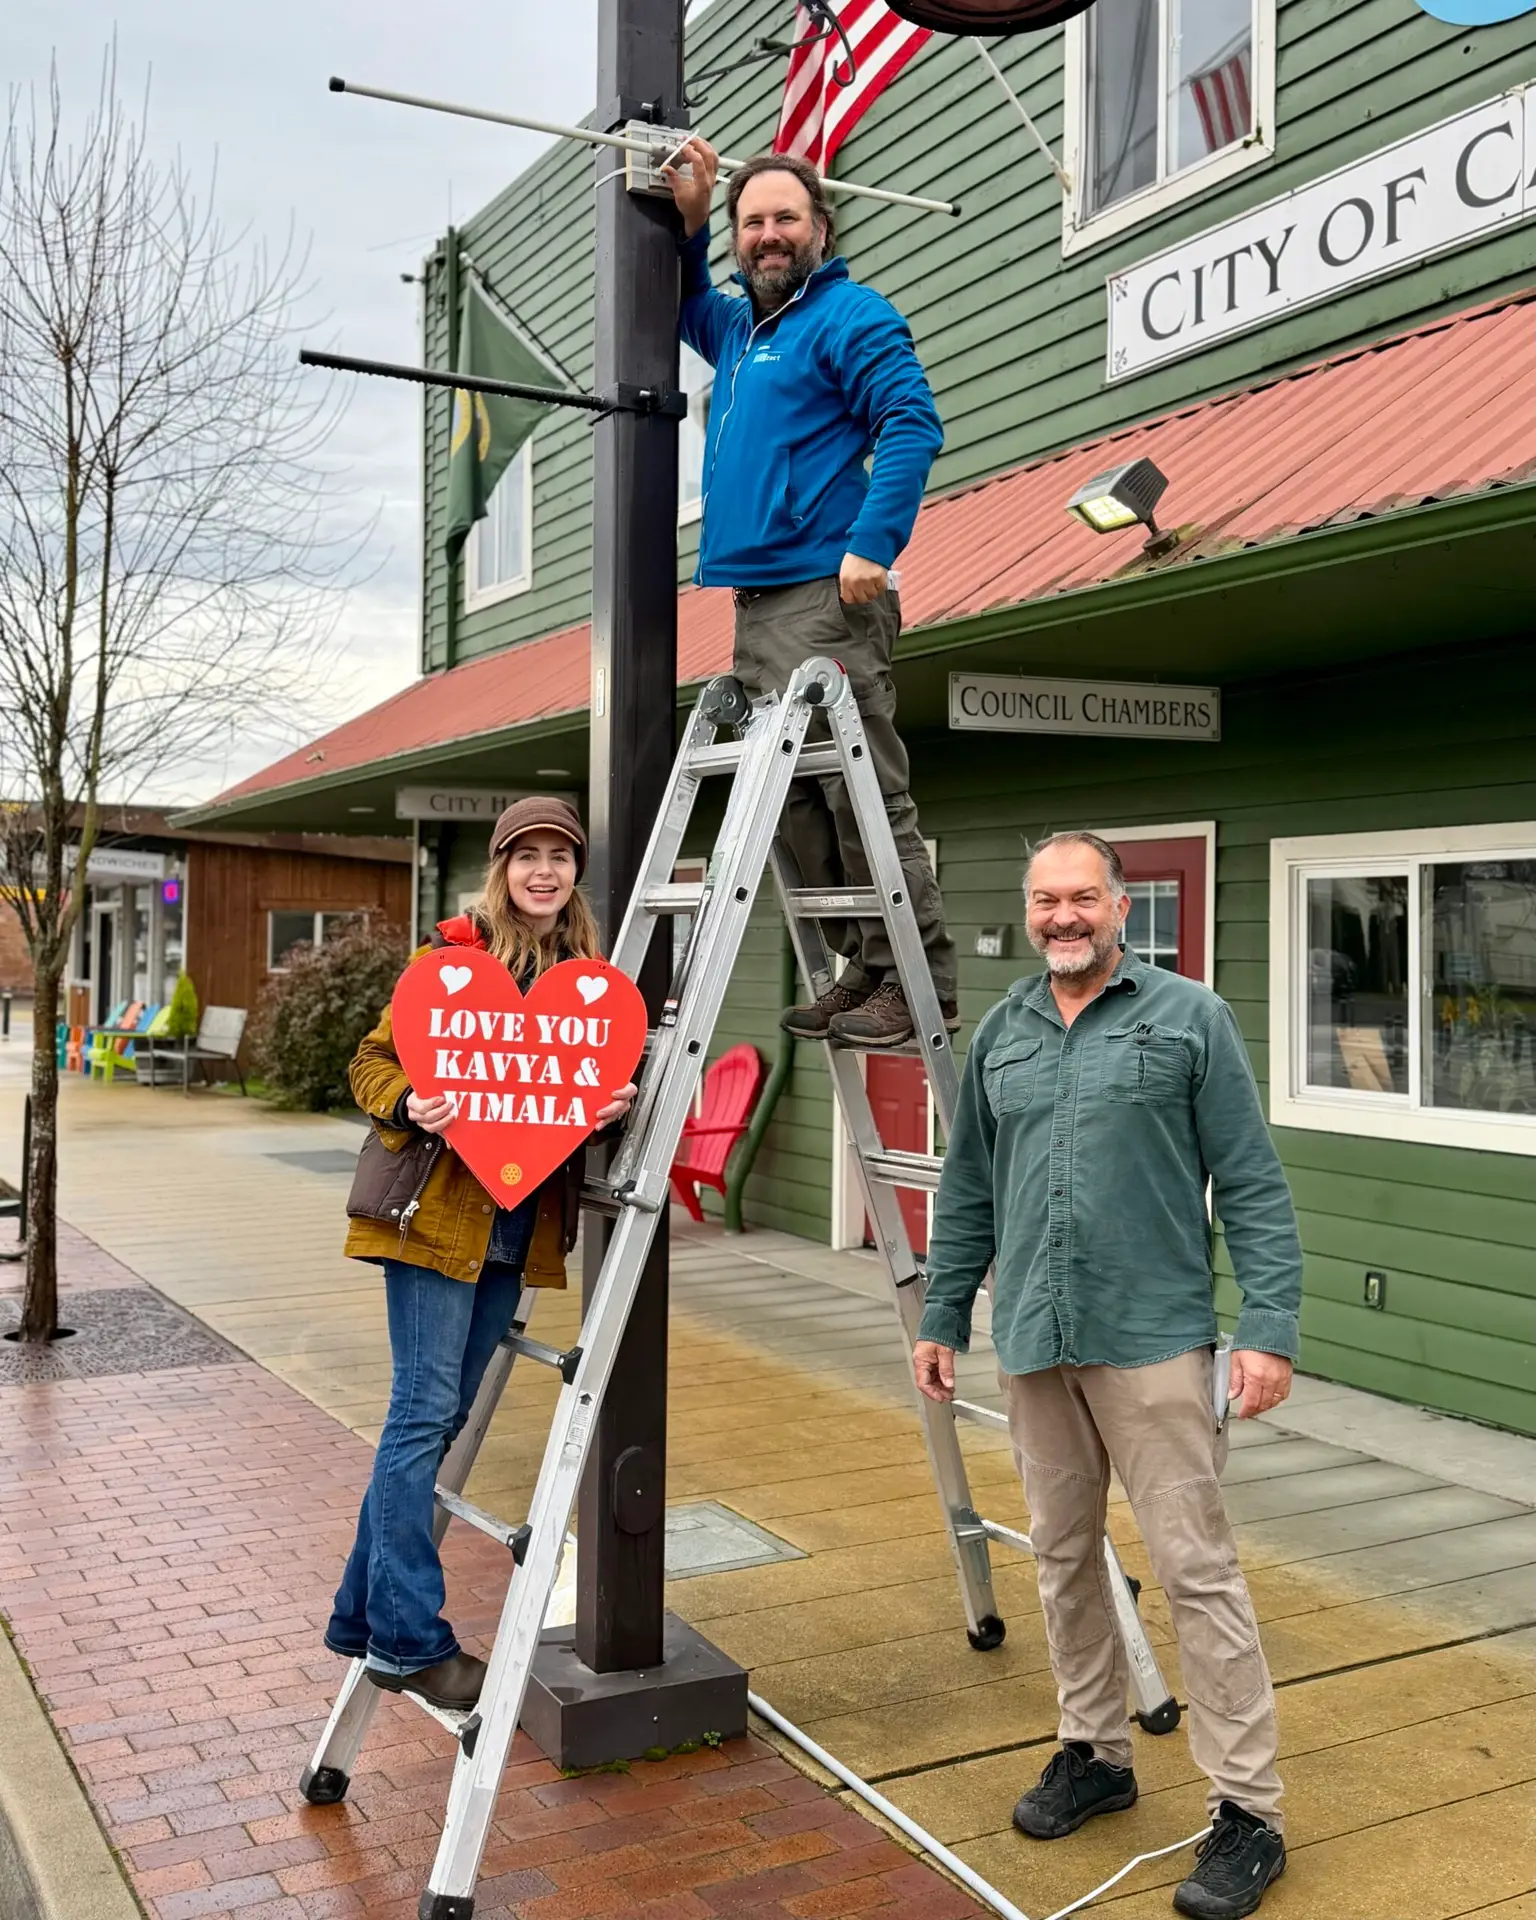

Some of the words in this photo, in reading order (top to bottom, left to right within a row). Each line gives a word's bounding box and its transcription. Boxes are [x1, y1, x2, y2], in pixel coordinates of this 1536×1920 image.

[1141, 223, 1298, 341] CITY
[1318, 166, 1428, 268] OF
[1455, 120, 1536, 209] C
[960, 685, 1074, 722] COUNCIL
[1082, 693, 1212, 729] CHAMBERS
[67, 850, 160, 871] SNDWICHES
[428, 1007, 525, 1043] LOVE
[535, 1014, 612, 1048] YOU
[434, 1048, 564, 1086] KAVYA
[573, 1056, 601, 1087] &
[443, 1089, 588, 1127] VIMALA
